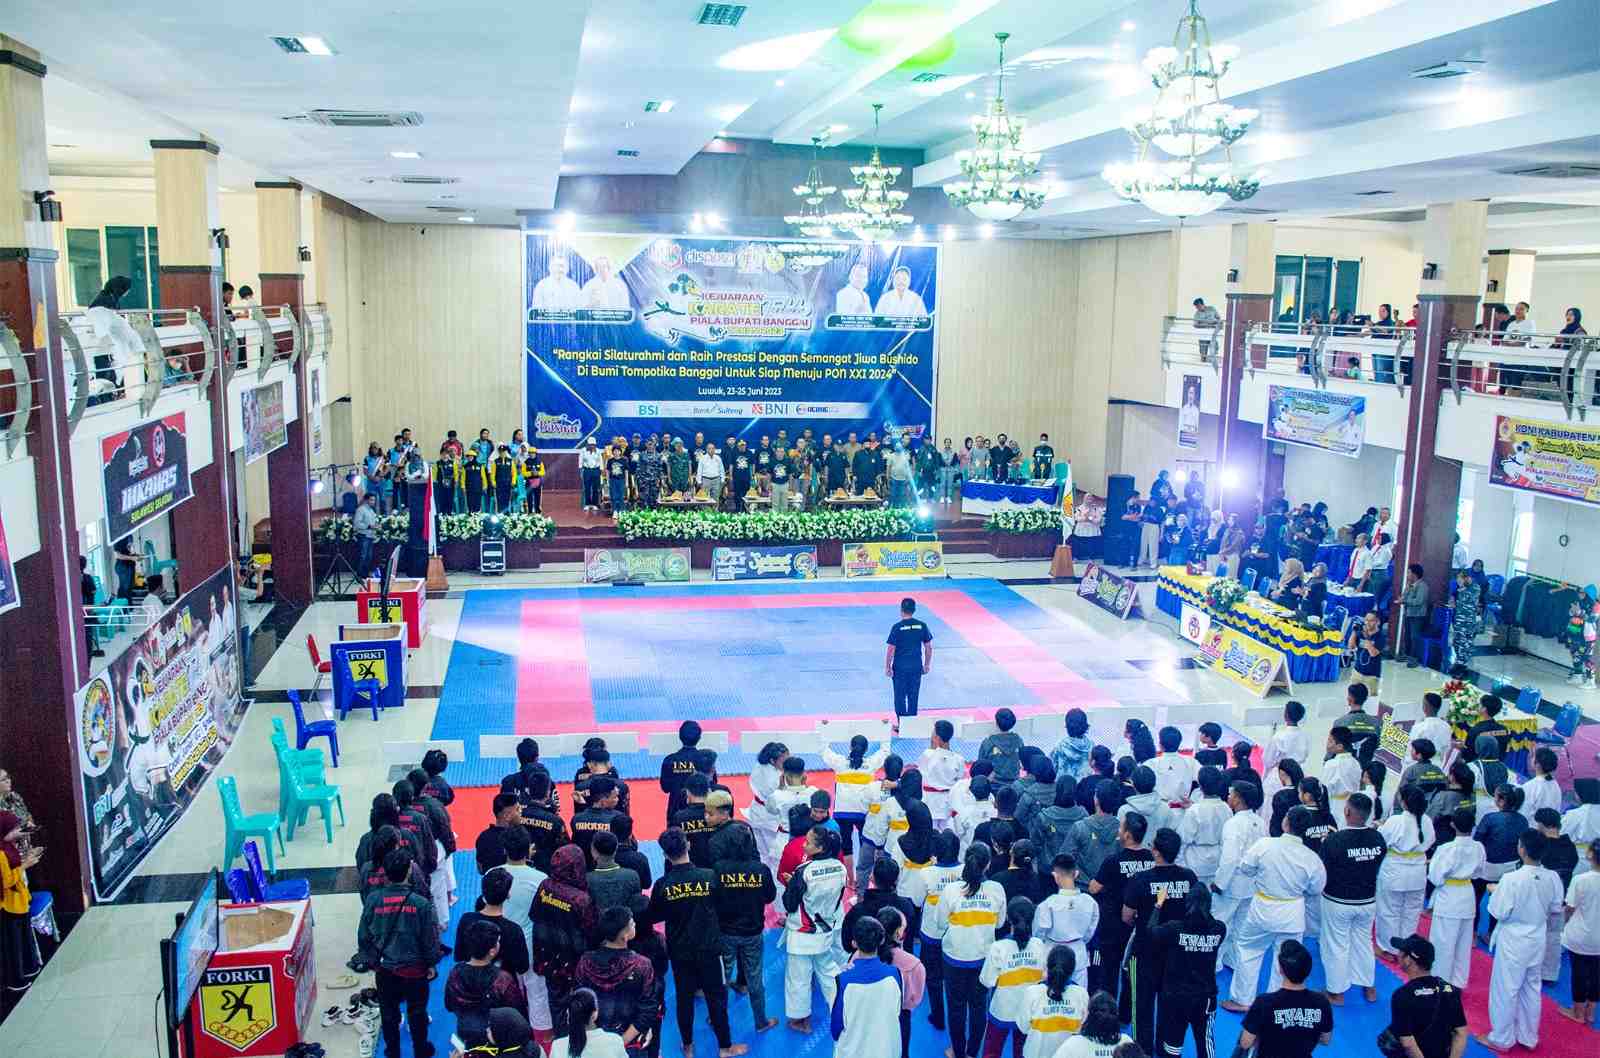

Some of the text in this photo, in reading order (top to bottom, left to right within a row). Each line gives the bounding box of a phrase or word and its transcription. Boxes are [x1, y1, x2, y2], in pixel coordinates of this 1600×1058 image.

[604, 349, 665, 362] Silaturahmi
[667, 350, 689, 362] dan
[690, 350, 714, 362] Raih
[716, 351, 756, 363] Prestasi
[758, 352, 798, 365] Dengan
[800, 352, 851, 366] Semangat
[853, 352, 877, 365] Jiwa
[880, 352, 919, 365] Bushido
[577, 365, 589, 377] Di
[591, 365, 620, 377] Bumi
[621, 365, 677, 380] Tompotika
[679, 366, 723, 380] Banggai
[725, 367, 756, 378] Untuk
[758, 367, 781, 381] Siap
[783, 367, 823, 381] Menuju
[825, 368, 847, 379] PON
[698, 386, 726, 396] Luwuk,
[747, 387, 764, 397] Juni
[765, 387, 783, 396] 2023
[638, 405, 659, 416] BSI
[765, 404, 788, 415] BNI
[1537, 427, 1595, 442] KABUPATEN
[350, 652, 384, 660] FORKI
[672, 760, 696, 769] INK
[680, 820, 705, 830] INK
[1119, 861, 1156, 874] EWAK
[720, 873, 763, 883] INKAI
[664, 881, 711, 897] INKAI
[1179, 933, 1222, 947] EWAKO
[207, 969, 265, 984] FORKI
[1273, 1008, 1322, 1024] EWAKO
